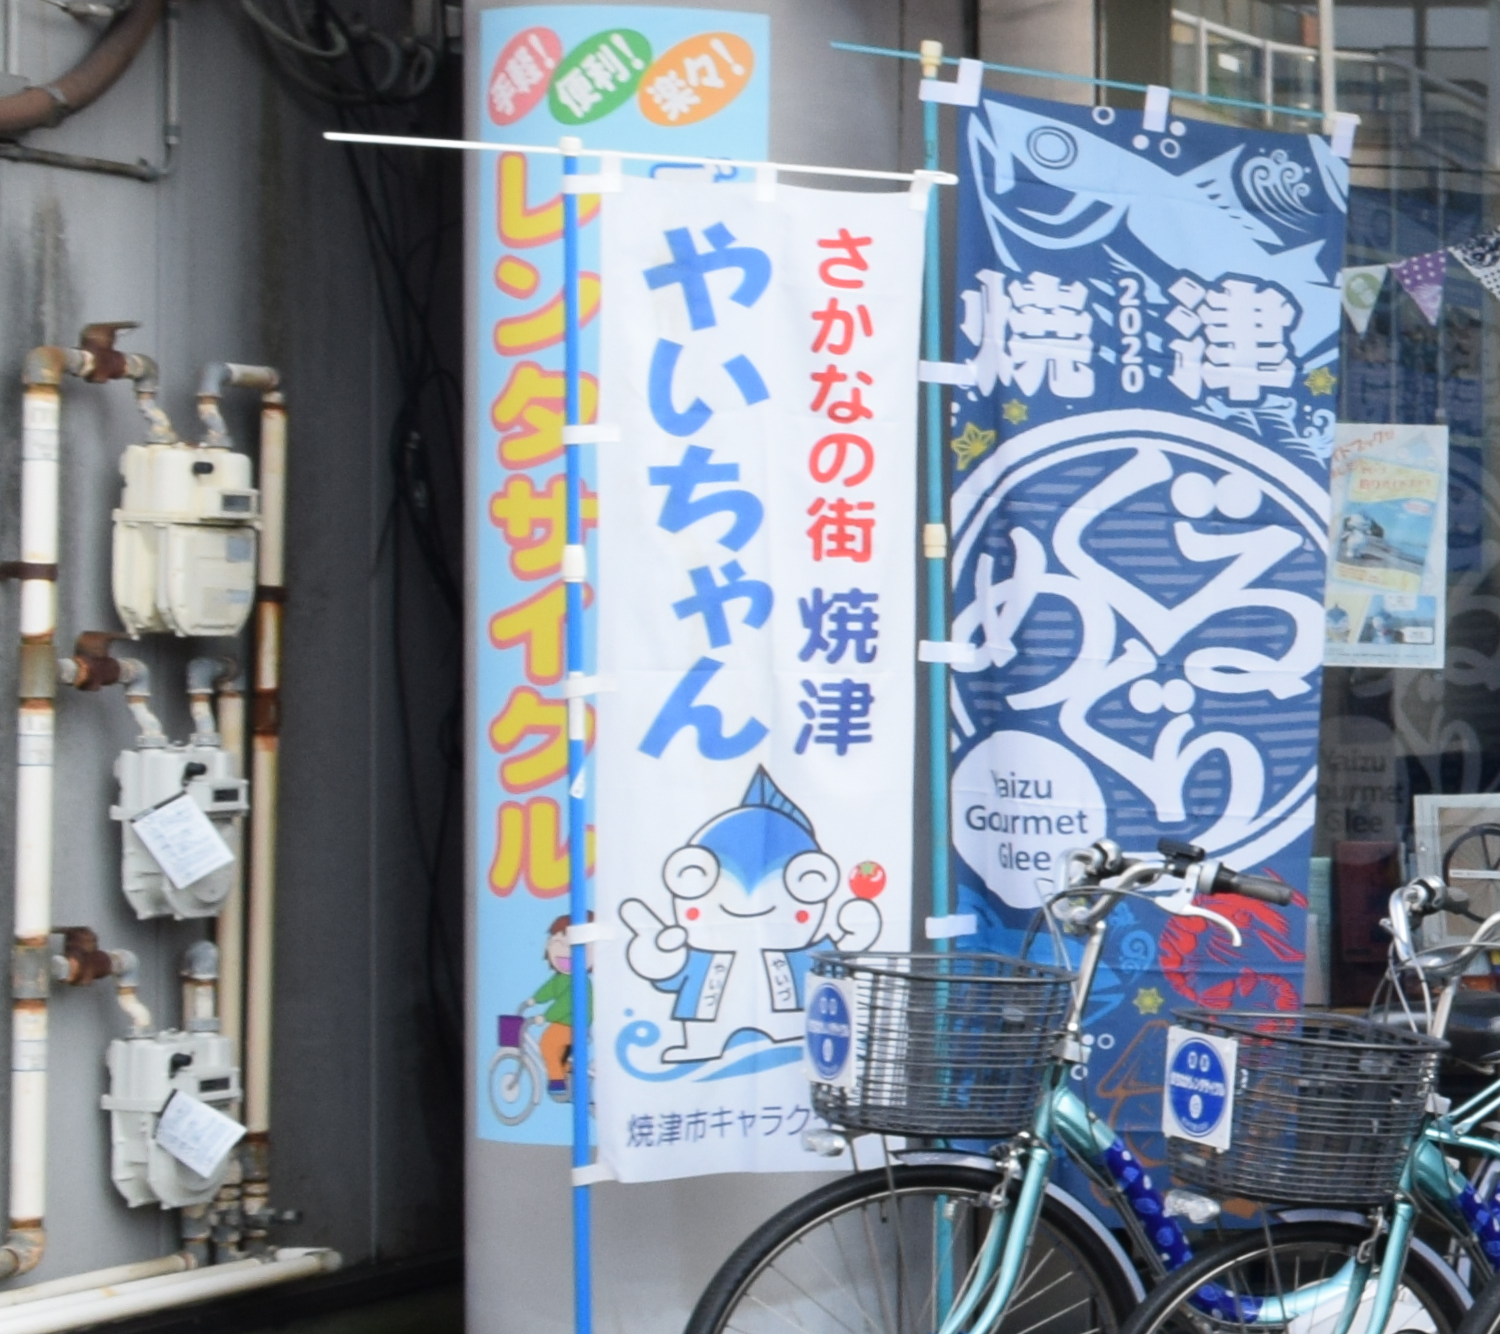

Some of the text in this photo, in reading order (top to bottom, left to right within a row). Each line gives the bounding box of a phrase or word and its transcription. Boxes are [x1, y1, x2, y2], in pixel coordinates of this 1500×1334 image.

[640, 220, 772, 761] やいちゃん
[794, 228, 879, 758] さかなの街 焼津
[626, 1103, 822, 1148] 焼津市キャラク
